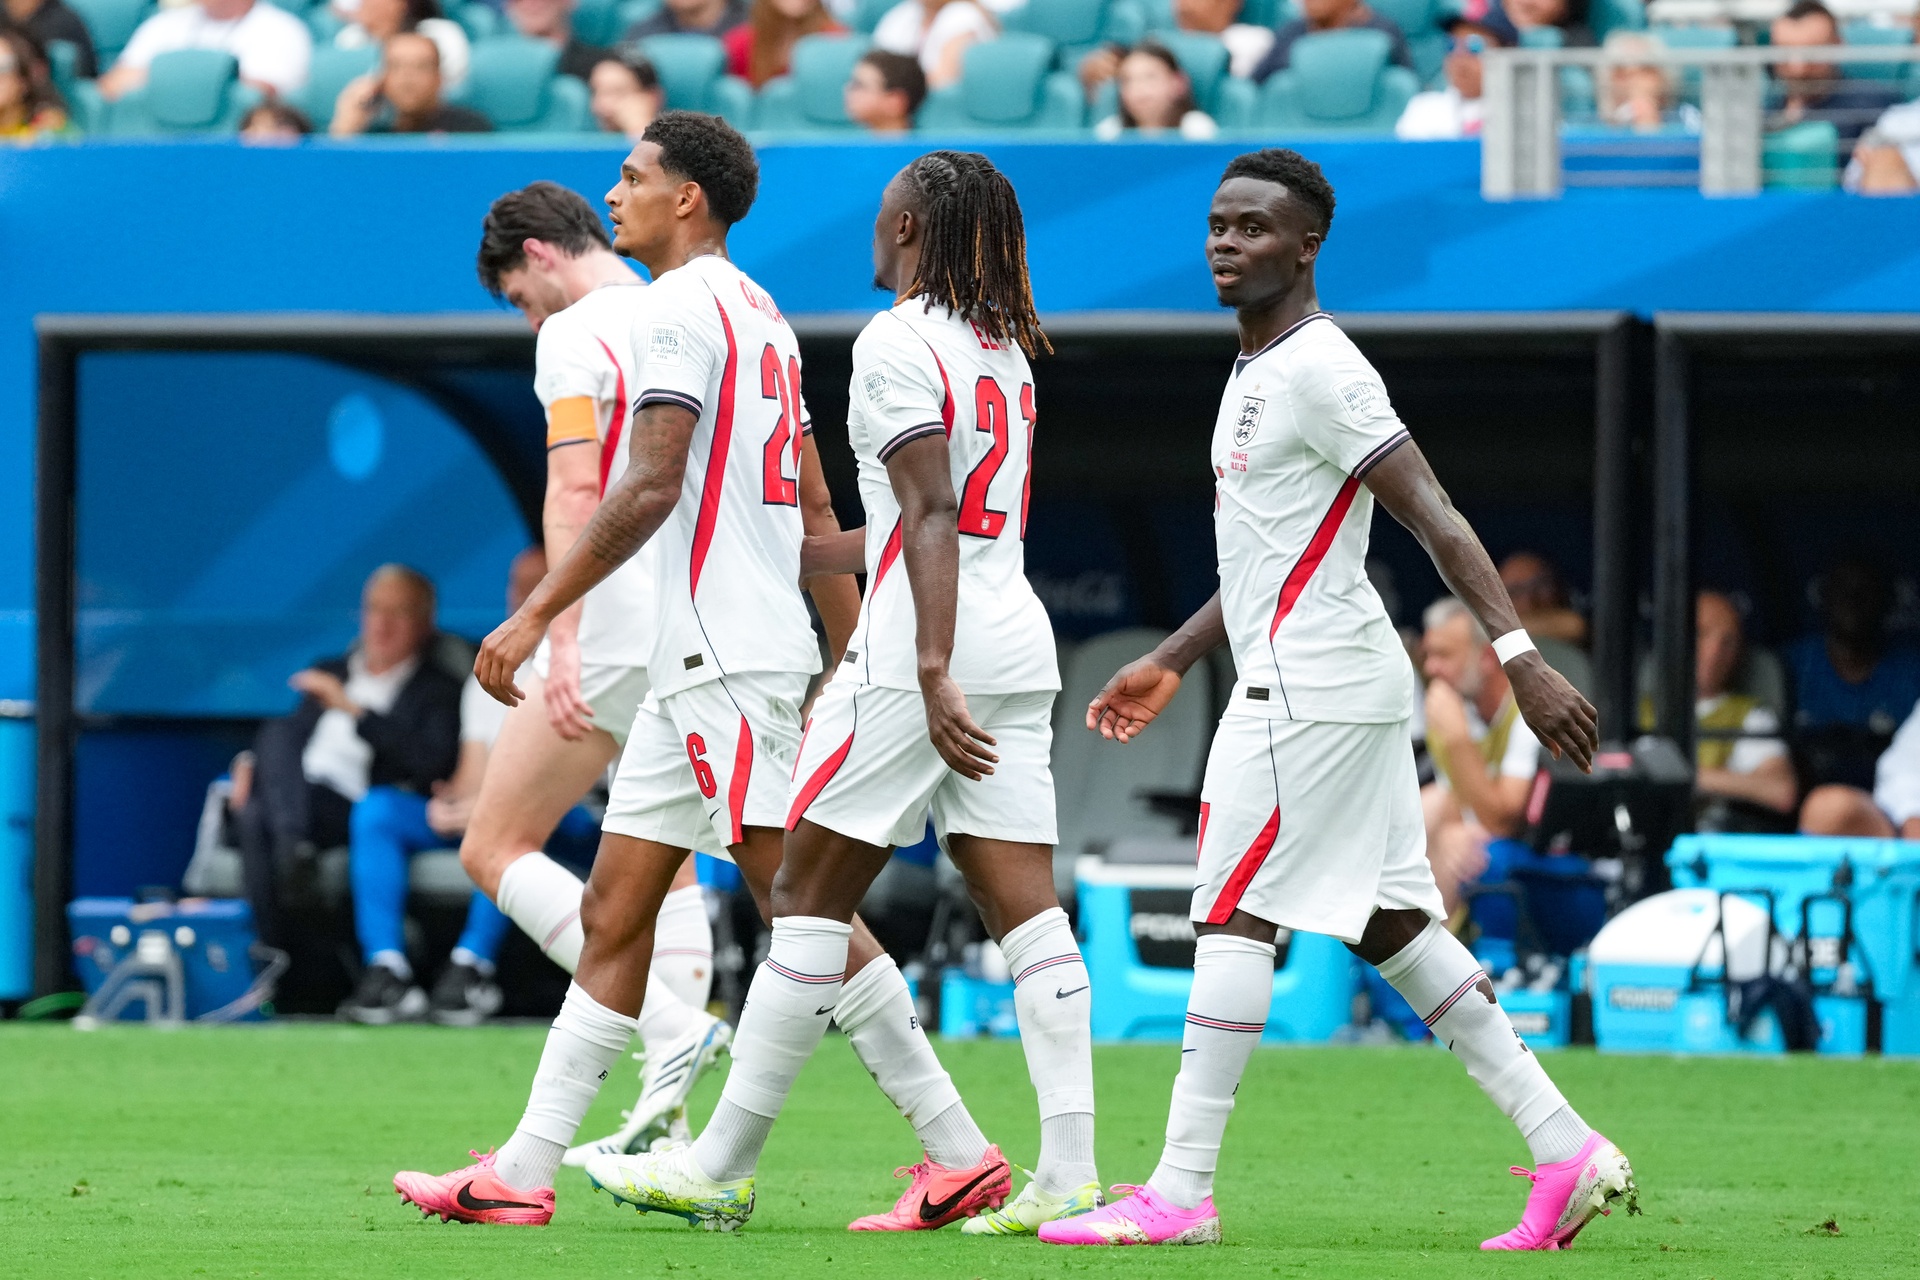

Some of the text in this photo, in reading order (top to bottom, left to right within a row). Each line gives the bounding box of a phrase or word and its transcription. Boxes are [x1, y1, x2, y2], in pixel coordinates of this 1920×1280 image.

[652, 327, 679, 338] FOOTBALL
[651, 335, 679, 347] UNITES
[862, 369, 884, 384] FOOTBALL
[864, 375, 887, 393] UNITES
[1340, 380, 1367, 396] FOOTBALL
[1344, 384, 1372, 404] UNITES
[1230, 451, 1249, 462] FRANCE
[686, 731, 718, 800] 6
